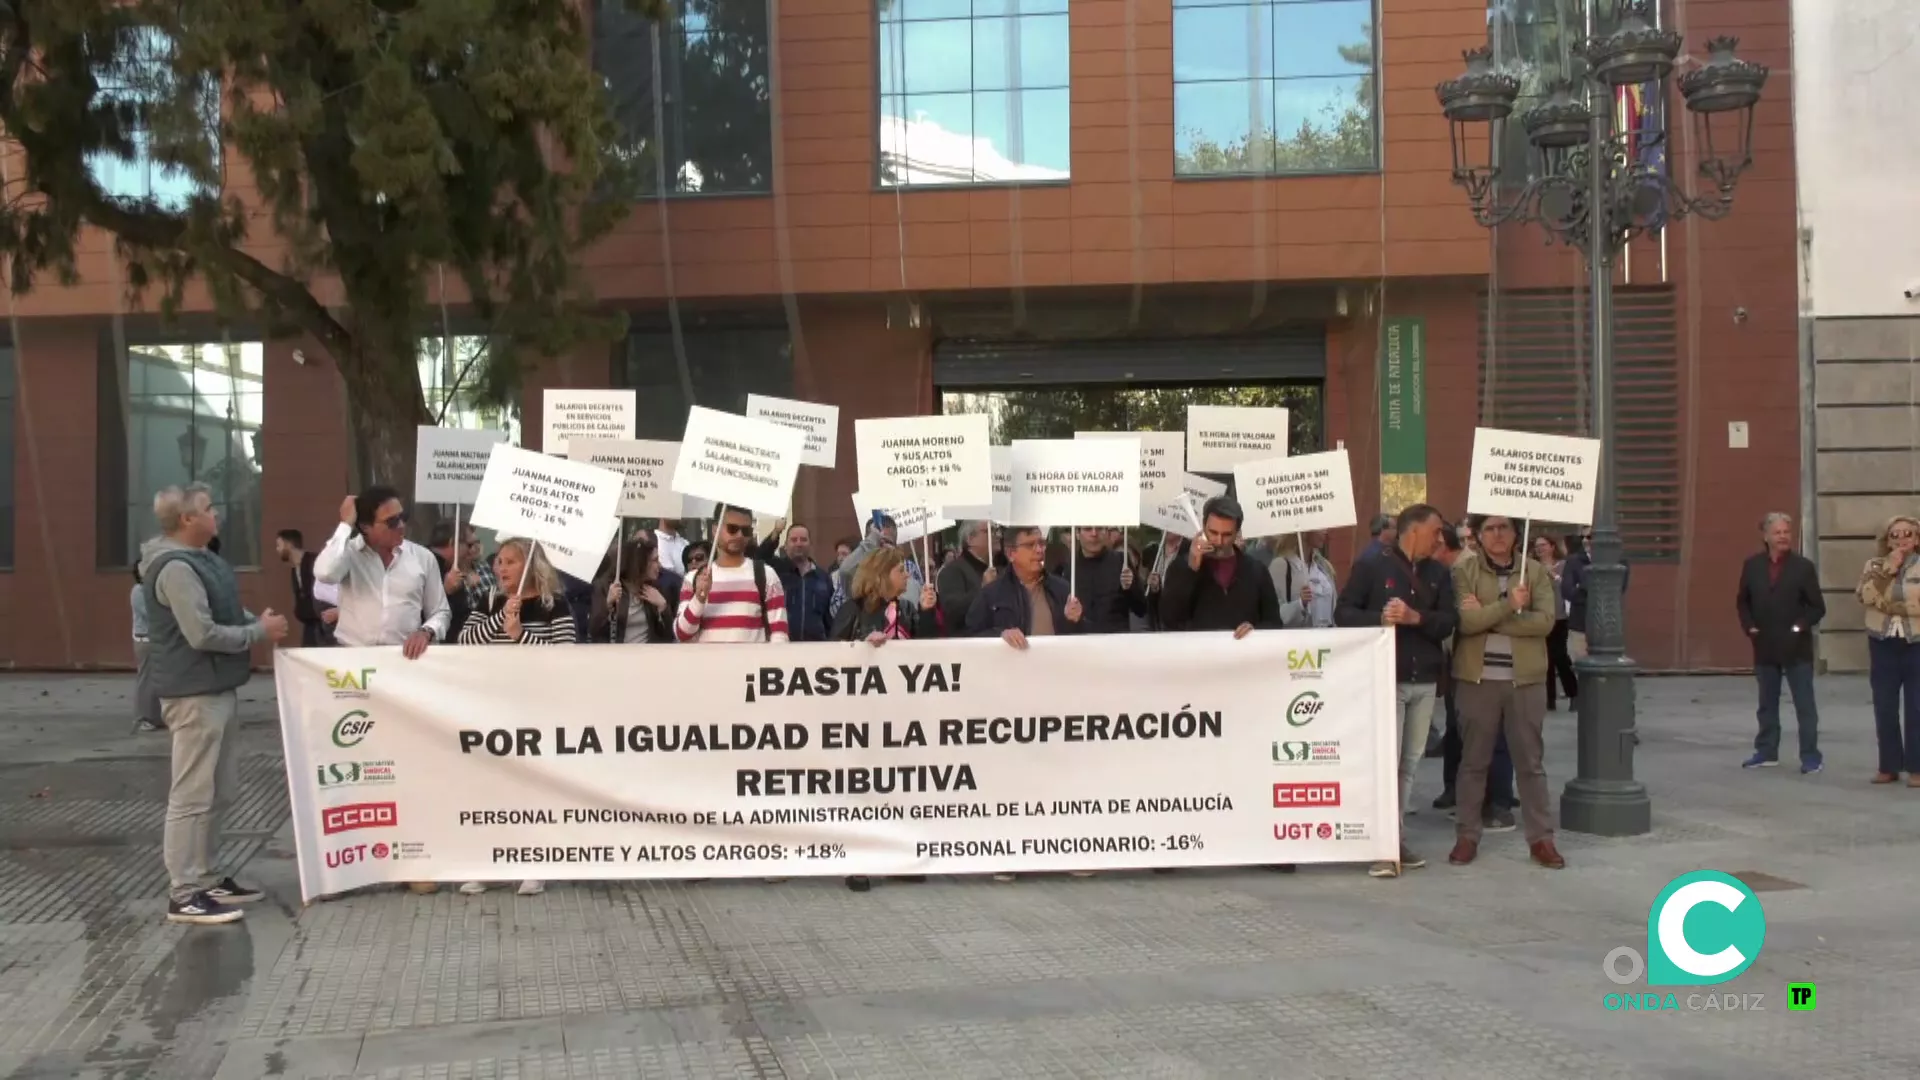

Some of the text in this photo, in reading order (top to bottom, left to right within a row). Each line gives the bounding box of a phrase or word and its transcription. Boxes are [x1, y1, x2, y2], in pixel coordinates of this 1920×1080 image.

[555, 403, 623, 412] SALARIOS DECENTES
[792, 413, 826, 425] DECENTES
[881, 435, 965, 448] JUANMA MORENO
[1210, 431, 1230, 439] HORA
[1242, 432, 1276, 440] VALORAR
[704, 436, 780, 460] JUANMA MALTRATA
[1150, 448, 1165, 456] SMI
[1203, 441, 1272, 450] NUESTRO TRABAJO
[432, 449, 460, 459] JUANMA
[591, 455, 664, 467] JUANMA MORENO
[705, 449, 771, 473] SALARIALMENTE
[902, 451, 921, 461] SUS
[923, 450, 952, 460] ALTOS
[1490, 447, 1582, 465] SALARIOS DECENTES
[433, 472, 446, 480] SUS
[626, 468, 652, 478] ALTOS
[699, 461, 715, 473] SUS
[716, 465, 779, 488] FUNCIONARIOS
[887, 465, 929, 475] CARGOS:
[940, 464, 950, 473] 18
[1026, 471, 1124, 480] ES HORA DE VALORAR
[1504, 462, 1565, 476] EN SERVICIOS
[512, 467, 596, 494] JUANMA MORENO
[926, 478, 937, 487] 16
[1267, 473, 1305, 485] AUXILIAR
[1314, 469, 1329, 479] SMI
[1484, 472, 1582, 491] PÚBLICOS DE CALIDAD
[529, 484, 548, 496] SUS
[549, 489, 580, 503] ALTOS
[626, 491, 636, 500] 16
[1030, 484, 1119, 493] NUESTRO TRABAJO
[1266, 483, 1312, 497] NOSOTROS
[1490, 487, 1574, 503] ¡SUBIDA SALARIAL!
[509, 493, 552, 509] CARGOS:
[561, 504, 573, 514] 18
[1256, 500, 1274, 510] QUE
[1275, 498, 1288, 507] NO
[1277, 509, 1292, 518] FIN
[1293, 507, 1304, 516] DE
[1305, 504, 1323, 513] MES
[544, 513, 556, 524] 16
[745, 663, 962, 702] ¡BASTA YA!
[460, 704, 1222, 756] POR LA IGUALDAD EN LA RECUPERACIÓN
[736, 764, 977, 796] RETRIBUTIVA
[1277, 788, 1336, 802] CCOO
[460, 792, 1233, 826] PERSONAL FUNCIONARIO DE LA ADMINISTRACIÓN GENERAL DE LA JUNTA DE ANDALUCÍA
[328, 808, 392, 828] CCOO
[1274, 823, 1313, 840] UGT
[492, 843, 847, 863] PRESIDENTE Y ALTOS CARGOS: +18%
[916, 834, 1204, 858] PERSONAL FUNCIONARIO: -16%
[326, 845, 367, 868] UGT
